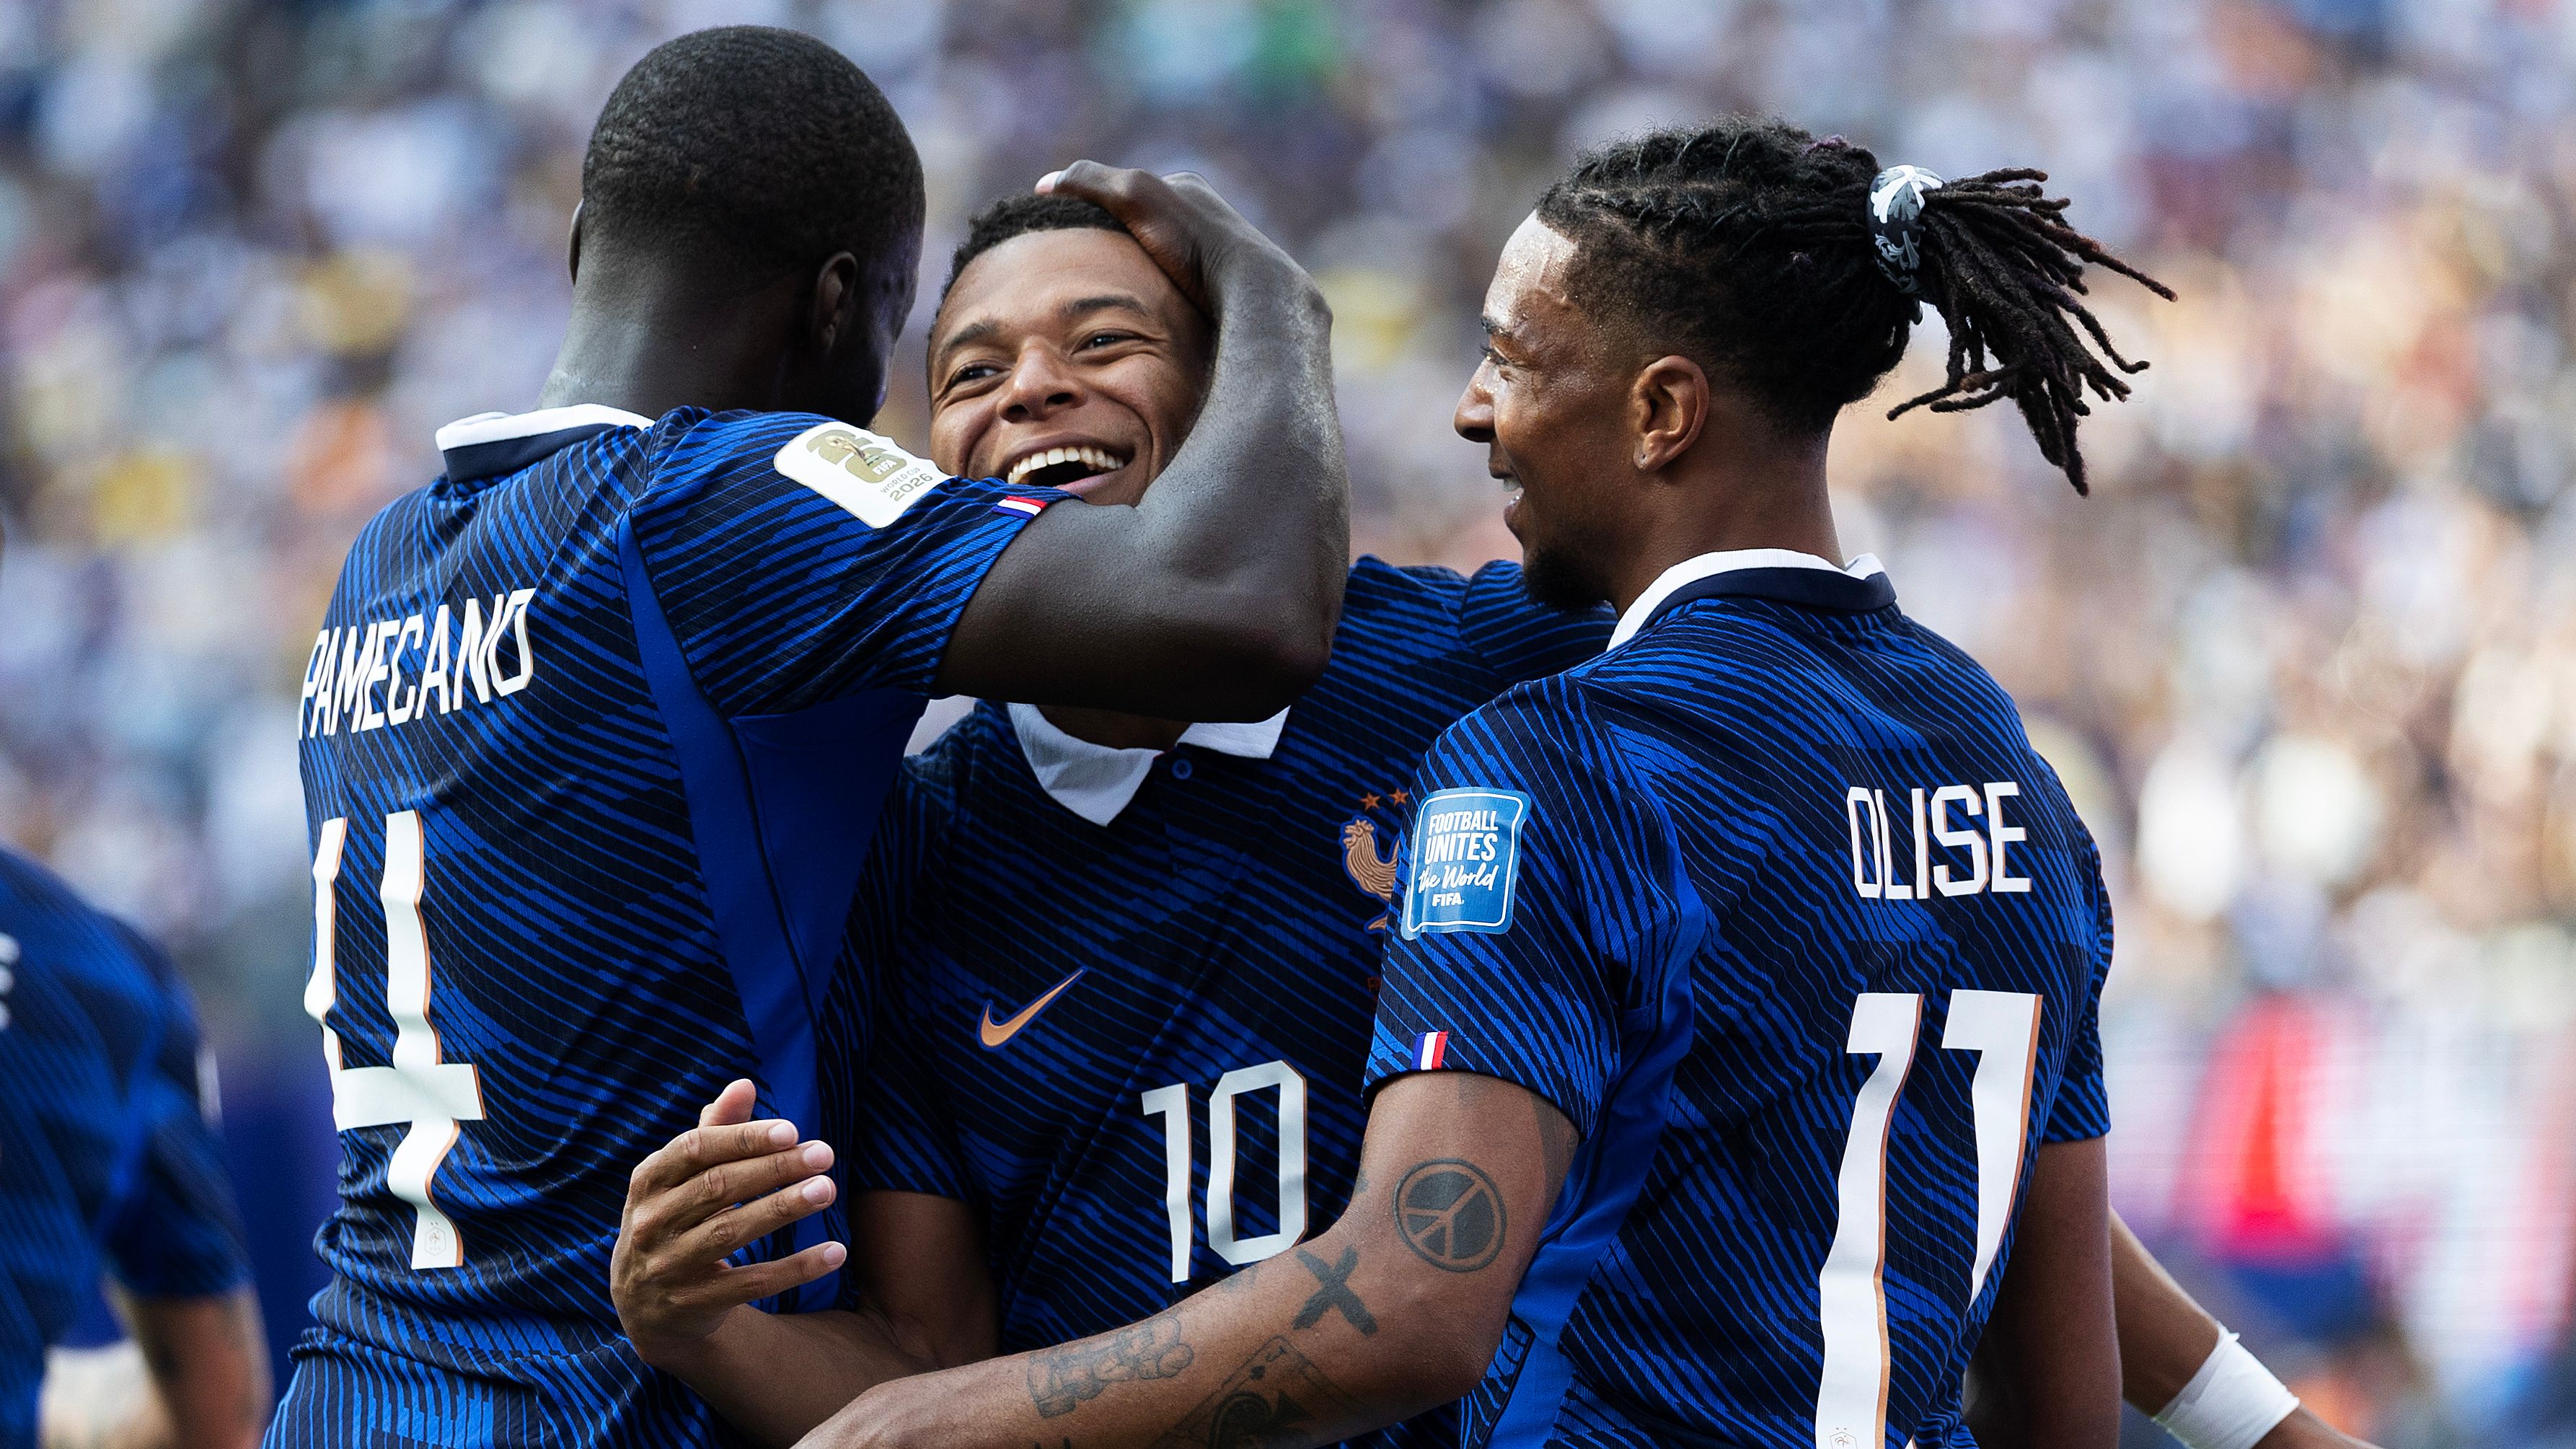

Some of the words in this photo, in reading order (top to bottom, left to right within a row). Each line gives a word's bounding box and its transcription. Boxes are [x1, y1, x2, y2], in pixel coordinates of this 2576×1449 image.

[872, 459, 898, 476] FIFA
[880, 473, 908, 494] WORLD
[907, 467, 921, 477] CUP
[889, 473, 933, 502] 2026
[1428, 810, 1499, 836] FOOTBALL
[1424, 832, 1499, 866] UNITES
[1846, 781, 2032, 900] OLISE
[1418, 866, 1441, 893] the
[1442, 863, 1499, 891] World
[303, 809, 488, 1270] 4
[1141, 1059, 1309, 1284] 10
[1814, 988, 2044, 1449] 11
